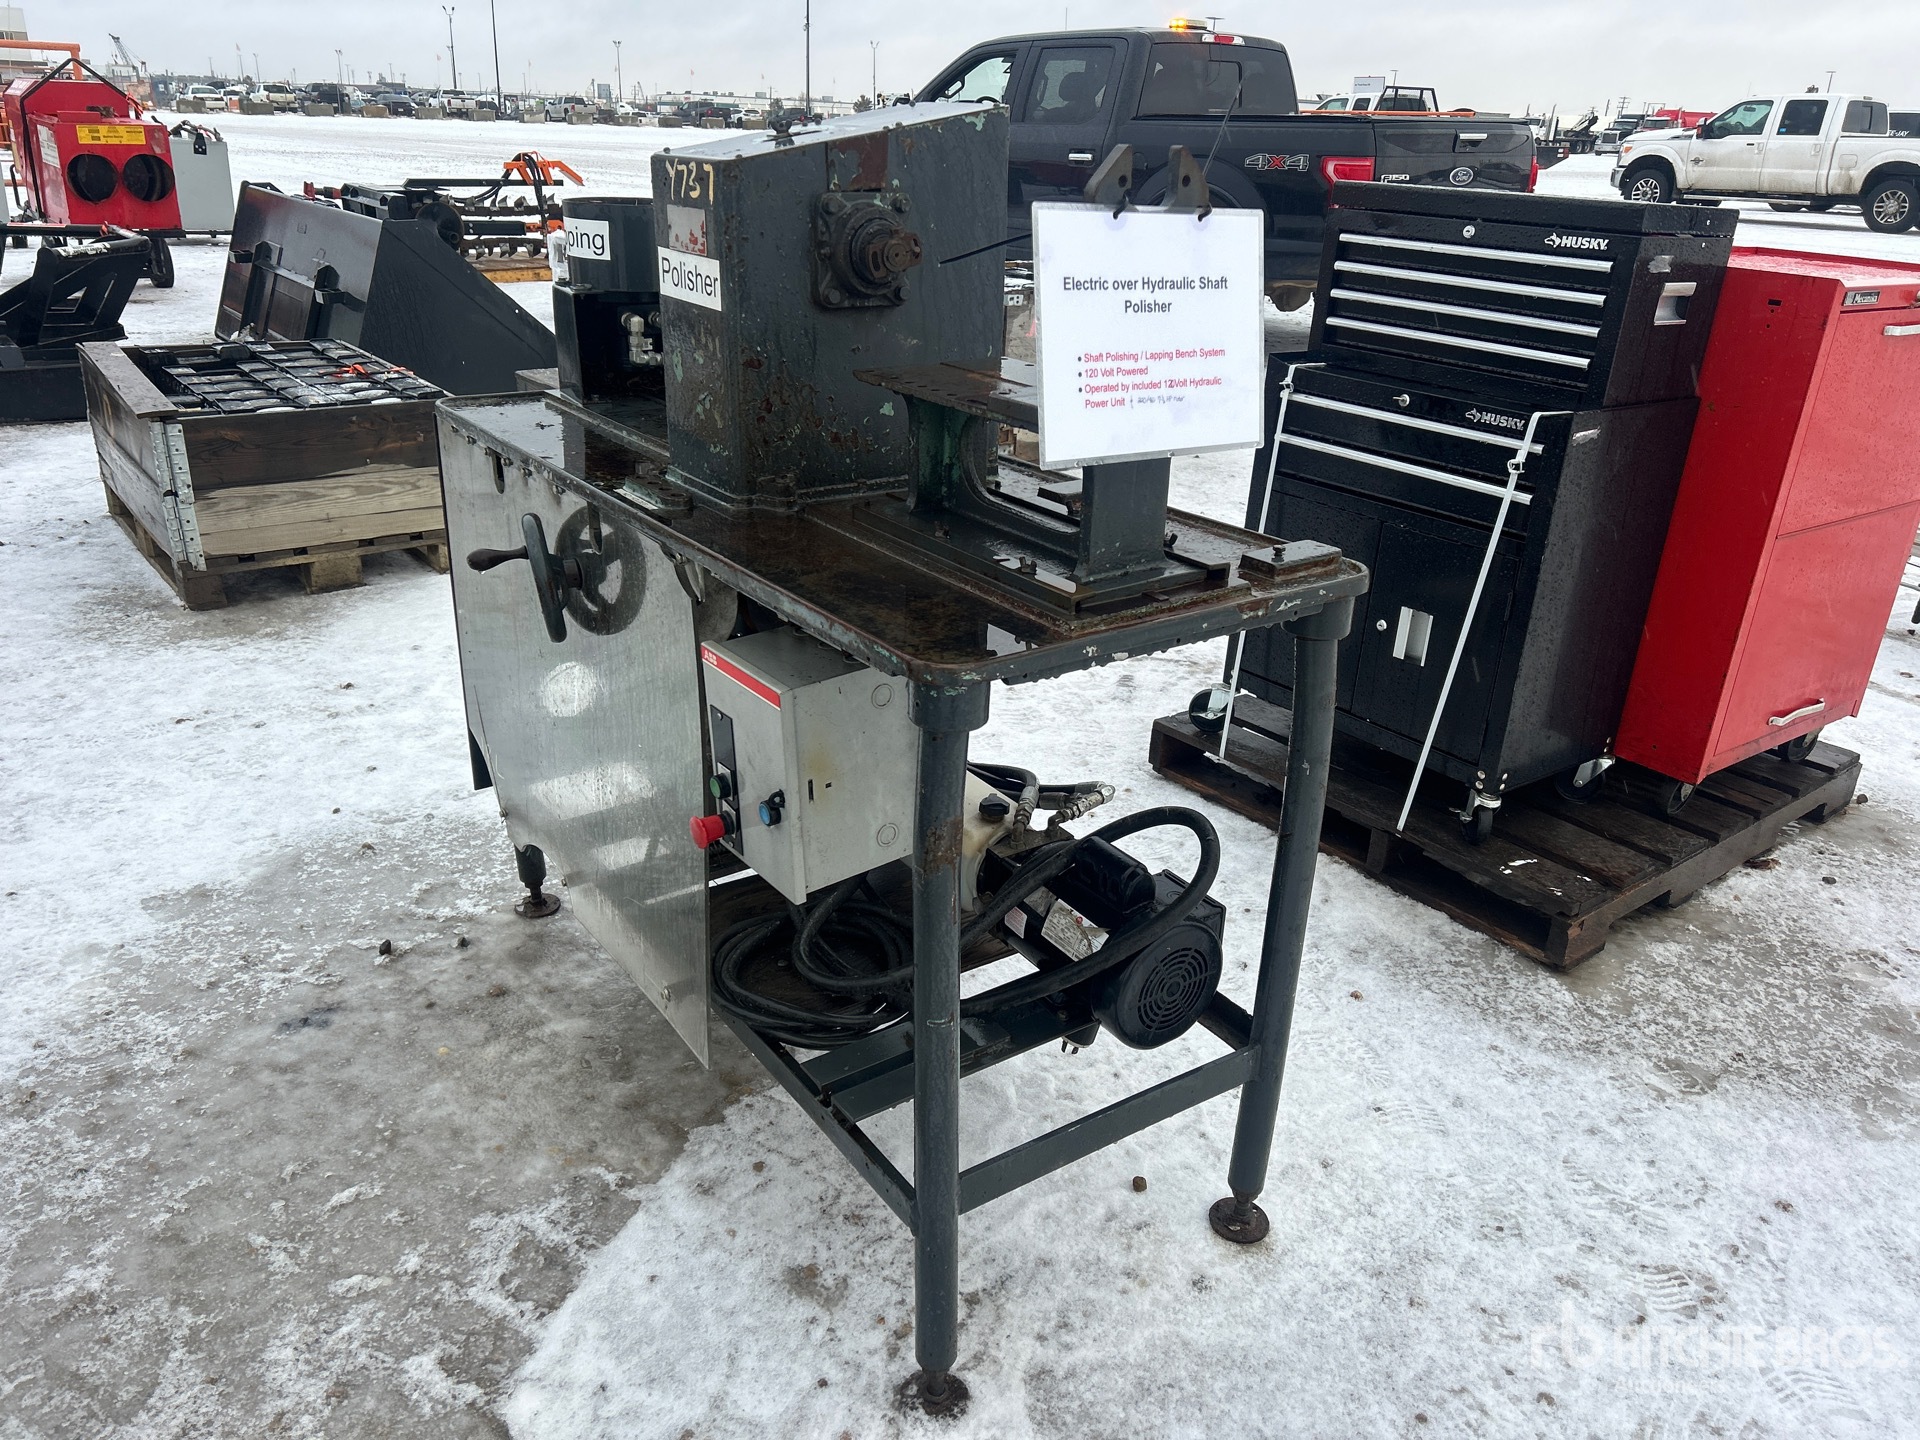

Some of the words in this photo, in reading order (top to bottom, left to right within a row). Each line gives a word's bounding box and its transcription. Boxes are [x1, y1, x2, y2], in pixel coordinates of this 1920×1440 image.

[1560, 235, 1609, 250] HUSKY
[661, 256, 718, 298] Polisher
[1063, 276, 1109, 291] Electric
[1112, 280, 1138, 291] over
[1142, 276, 1196, 294] Hydraulic
[1199, 275, 1228, 290] Shaft
[1124, 299, 1172, 314] Polisher
[1084, 352, 1104, 363] Shaft
[1105, 351, 1139, 363] Polishing
[1145, 350, 1173, 362] Lapping
[1175, 348, 1197, 359] Bench
[1199, 348, 1226, 359] System
[1084, 368, 1099, 378] 120
[1100, 367, 1114, 377] Volt
[1116, 366, 1149, 377] Powered
[1084, 382, 1119, 395] Operated
[1120, 381, 1129, 393] by
[1131, 379, 1161, 391] included
[1189, 376, 1222, 388] Hydraulic
[1085, 398, 1108, 409] Power
[1110, 397, 1126, 407] Unit
[1480, 411, 1525, 431] HUSKY
[704, 649, 718, 666] ABB
